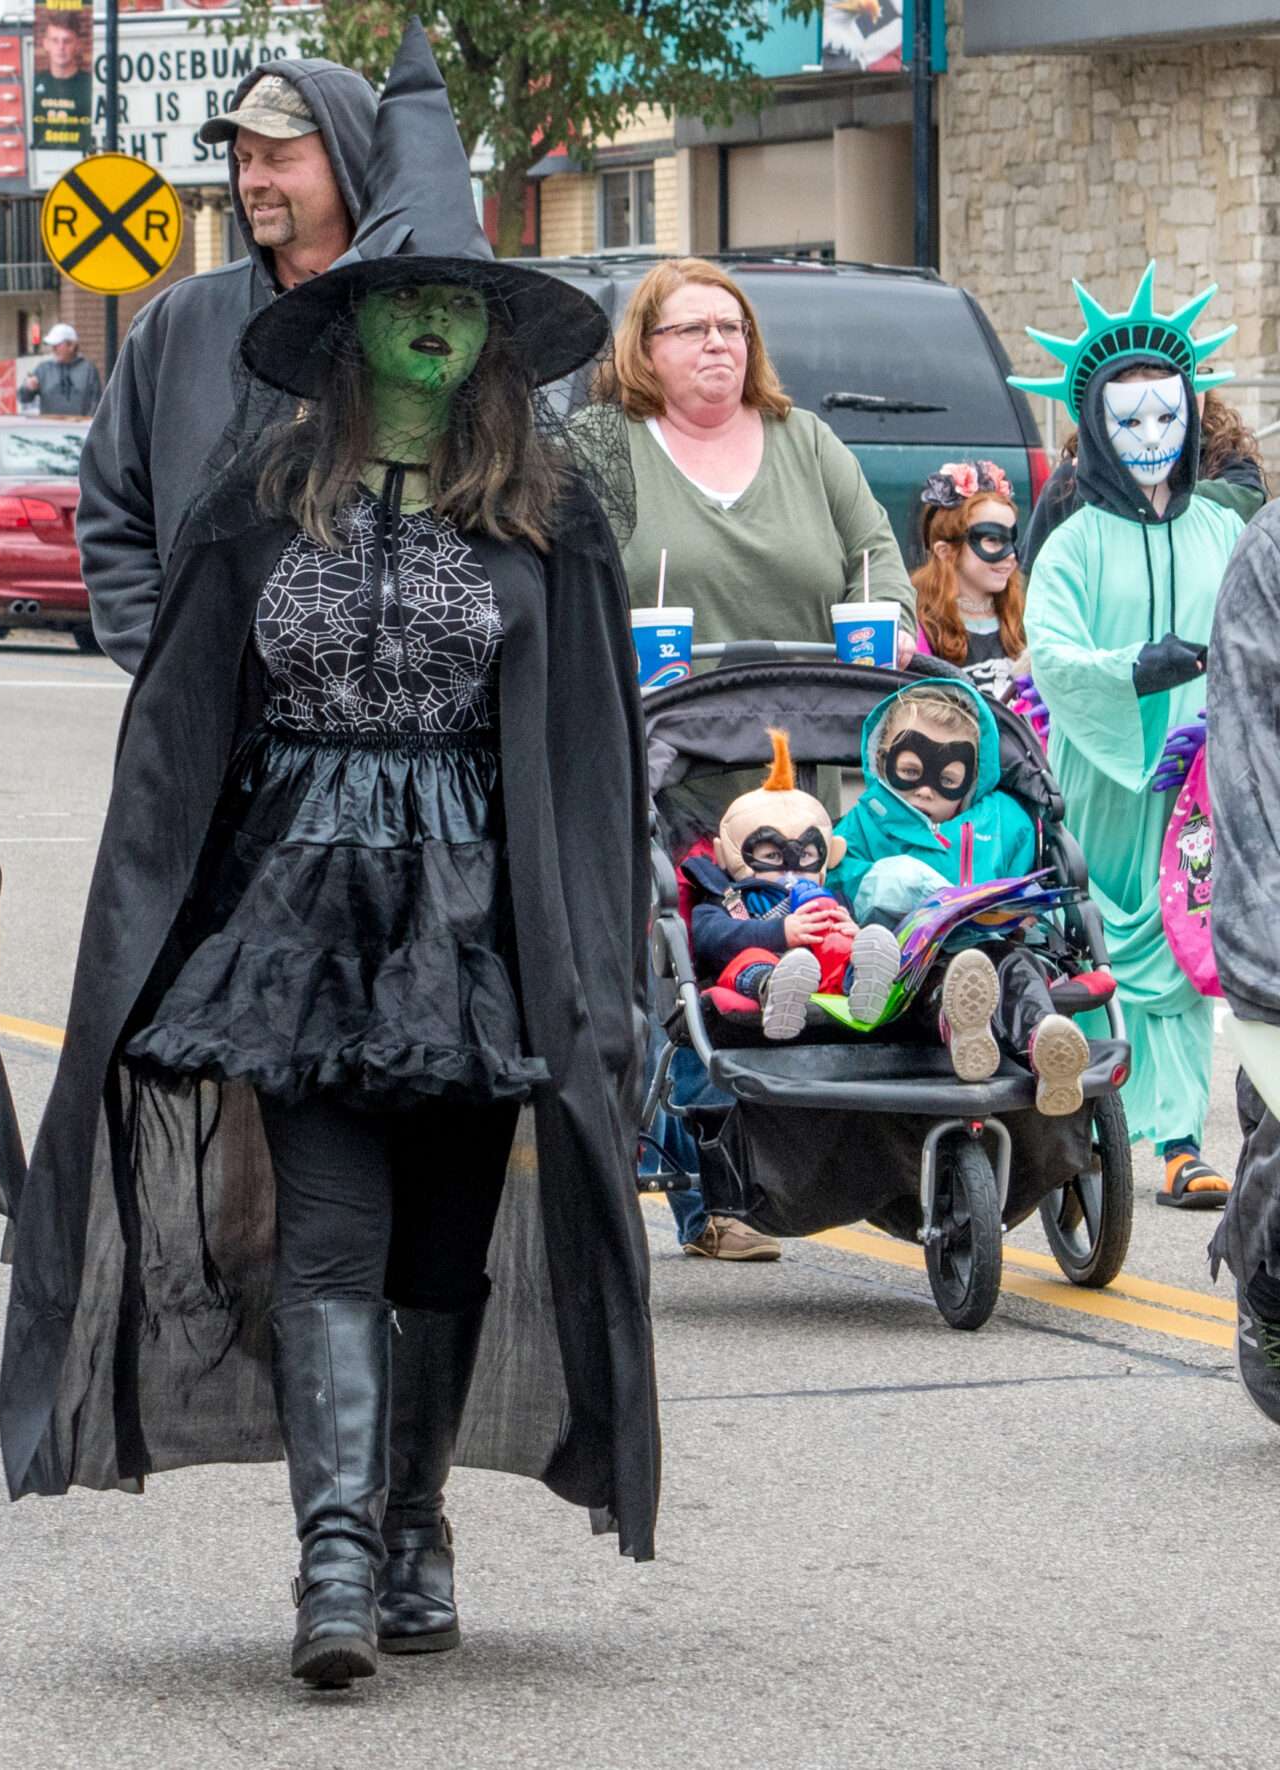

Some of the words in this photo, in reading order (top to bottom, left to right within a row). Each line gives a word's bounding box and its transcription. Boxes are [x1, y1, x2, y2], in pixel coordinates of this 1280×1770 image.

[157, 92, 180, 122] IS
[53, 207, 78, 237] R
[144, 210, 170, 242] R
[659, 643, 676, 659] 32
